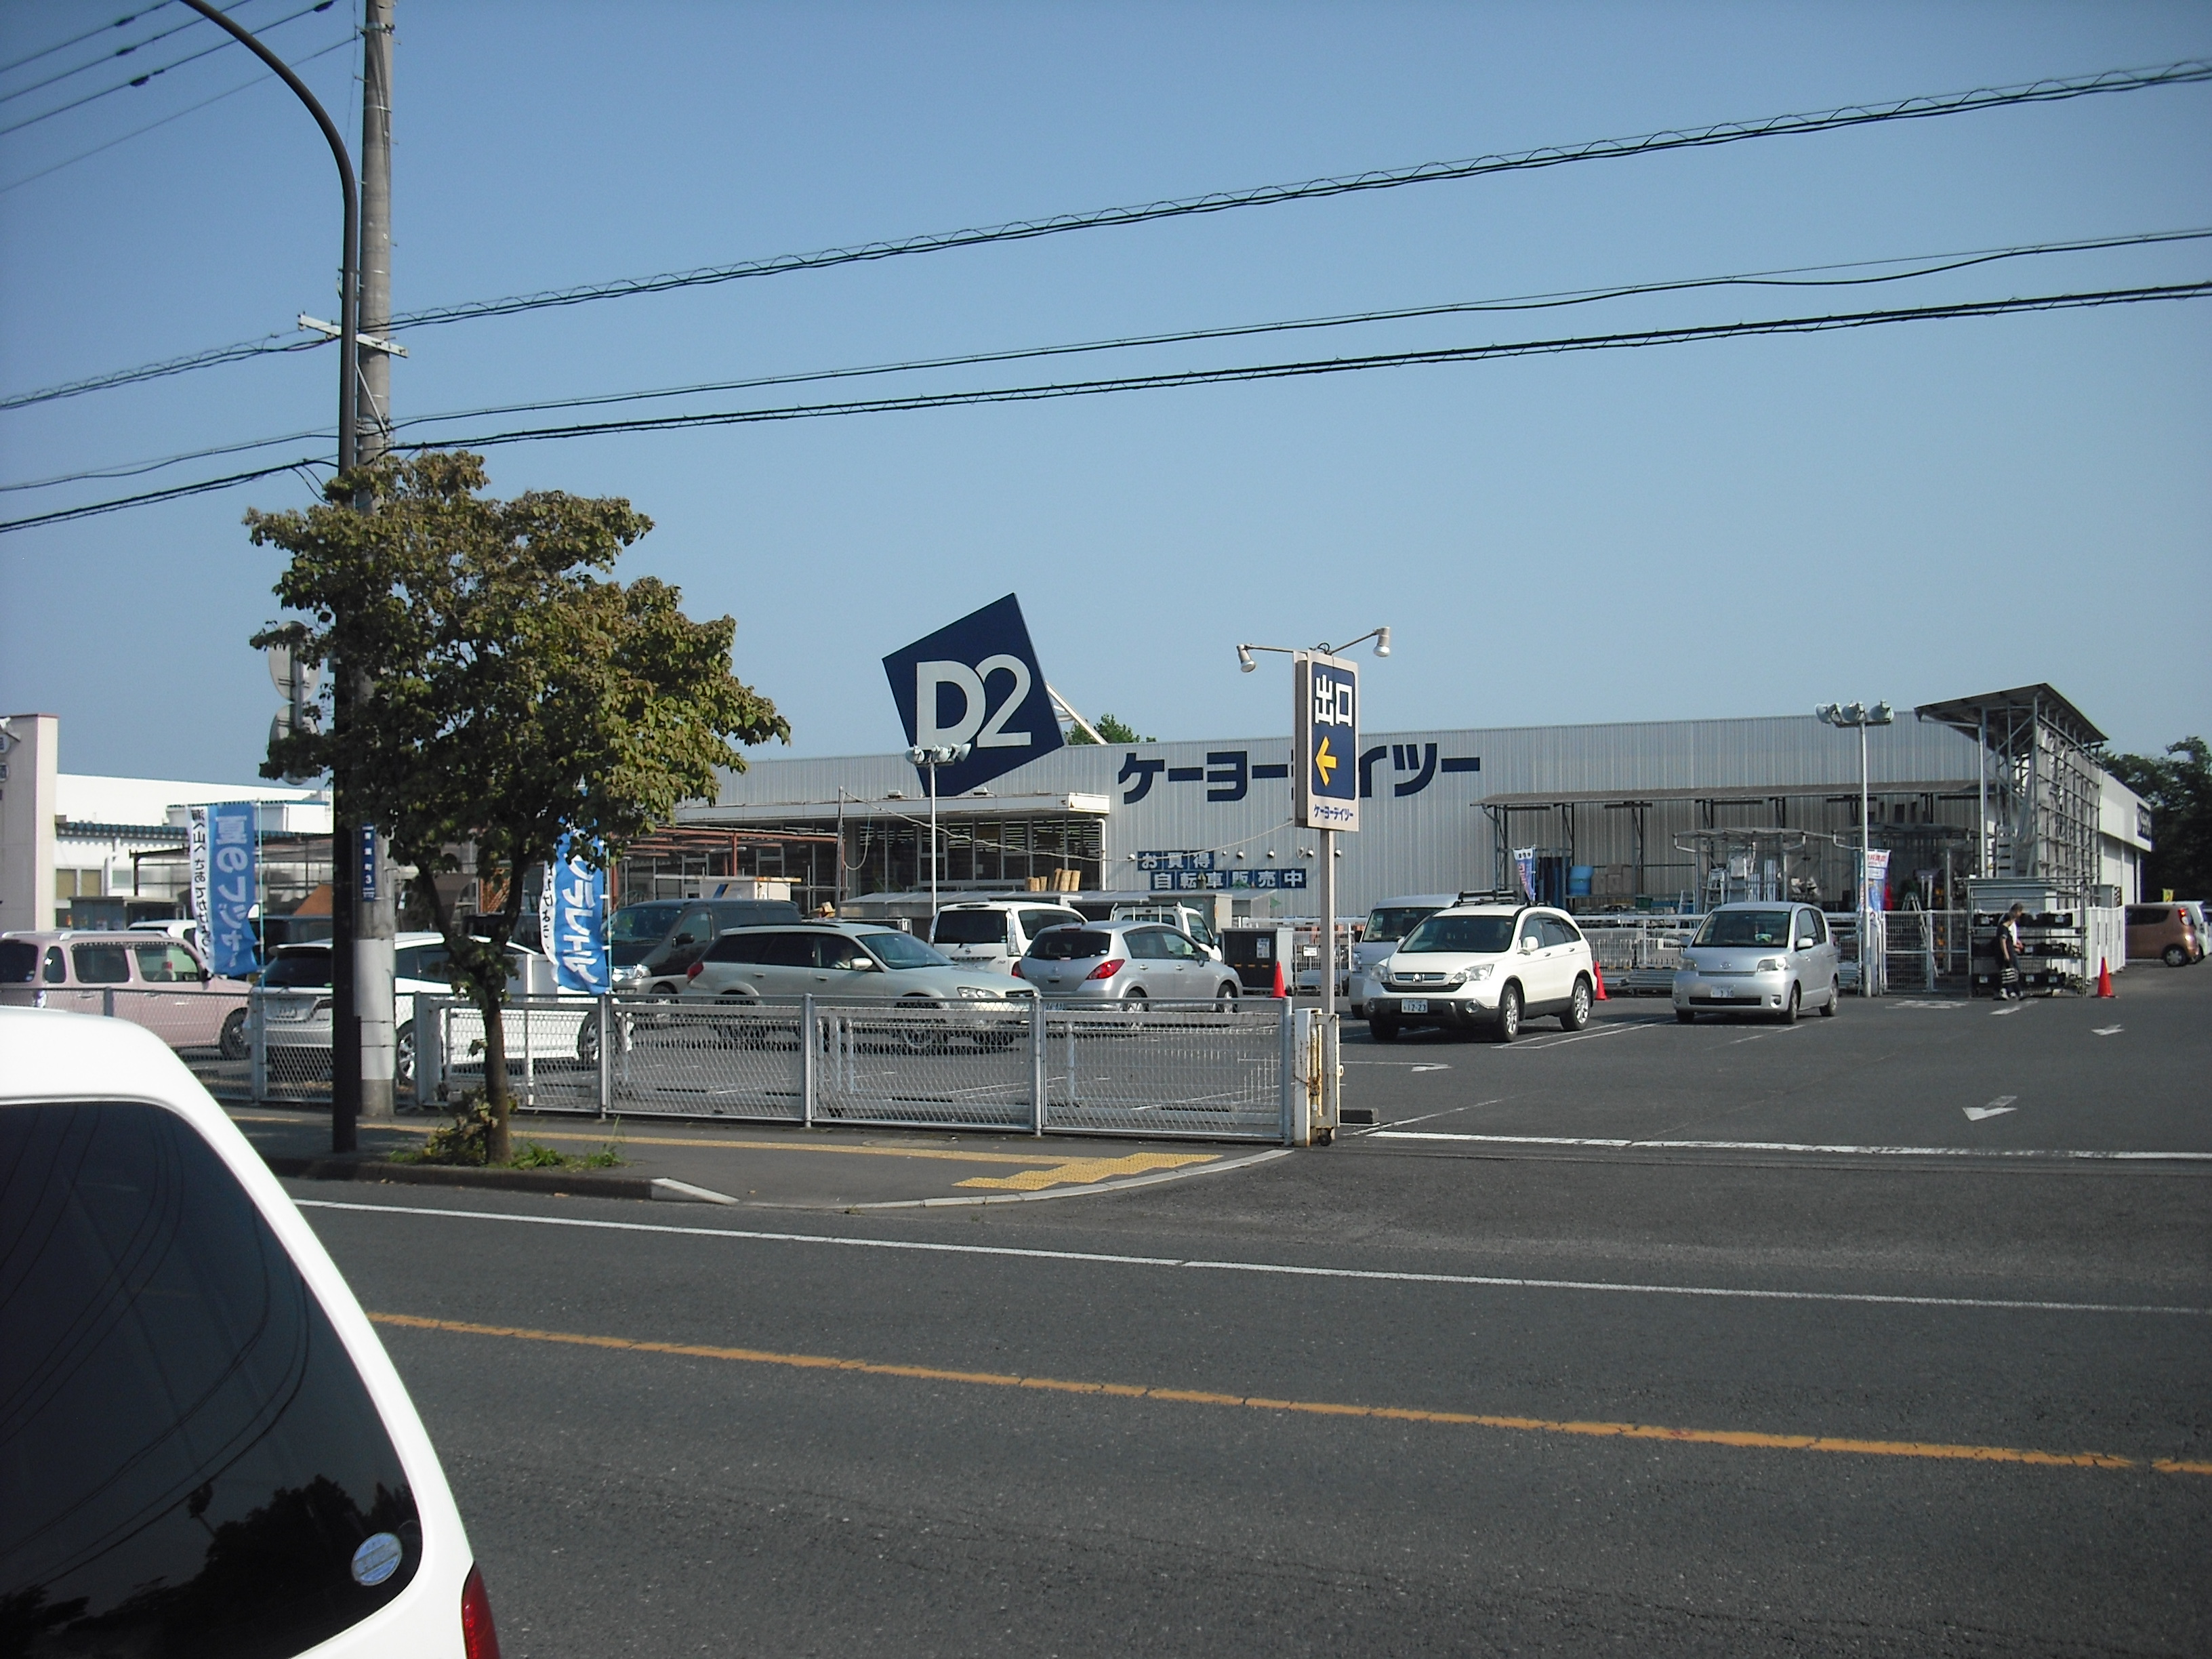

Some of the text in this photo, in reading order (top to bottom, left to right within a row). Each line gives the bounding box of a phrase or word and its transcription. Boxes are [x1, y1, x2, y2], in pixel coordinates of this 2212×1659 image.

[916, 654, 1031, 750] D2
[1315, 674, 1353, 727] 出口
[1118, 743, 1480, 804] ケーヨーイツー
[1141, 851, 1210, 870] お買得
[1153, 869, 1304, 890] 自転車販売中
